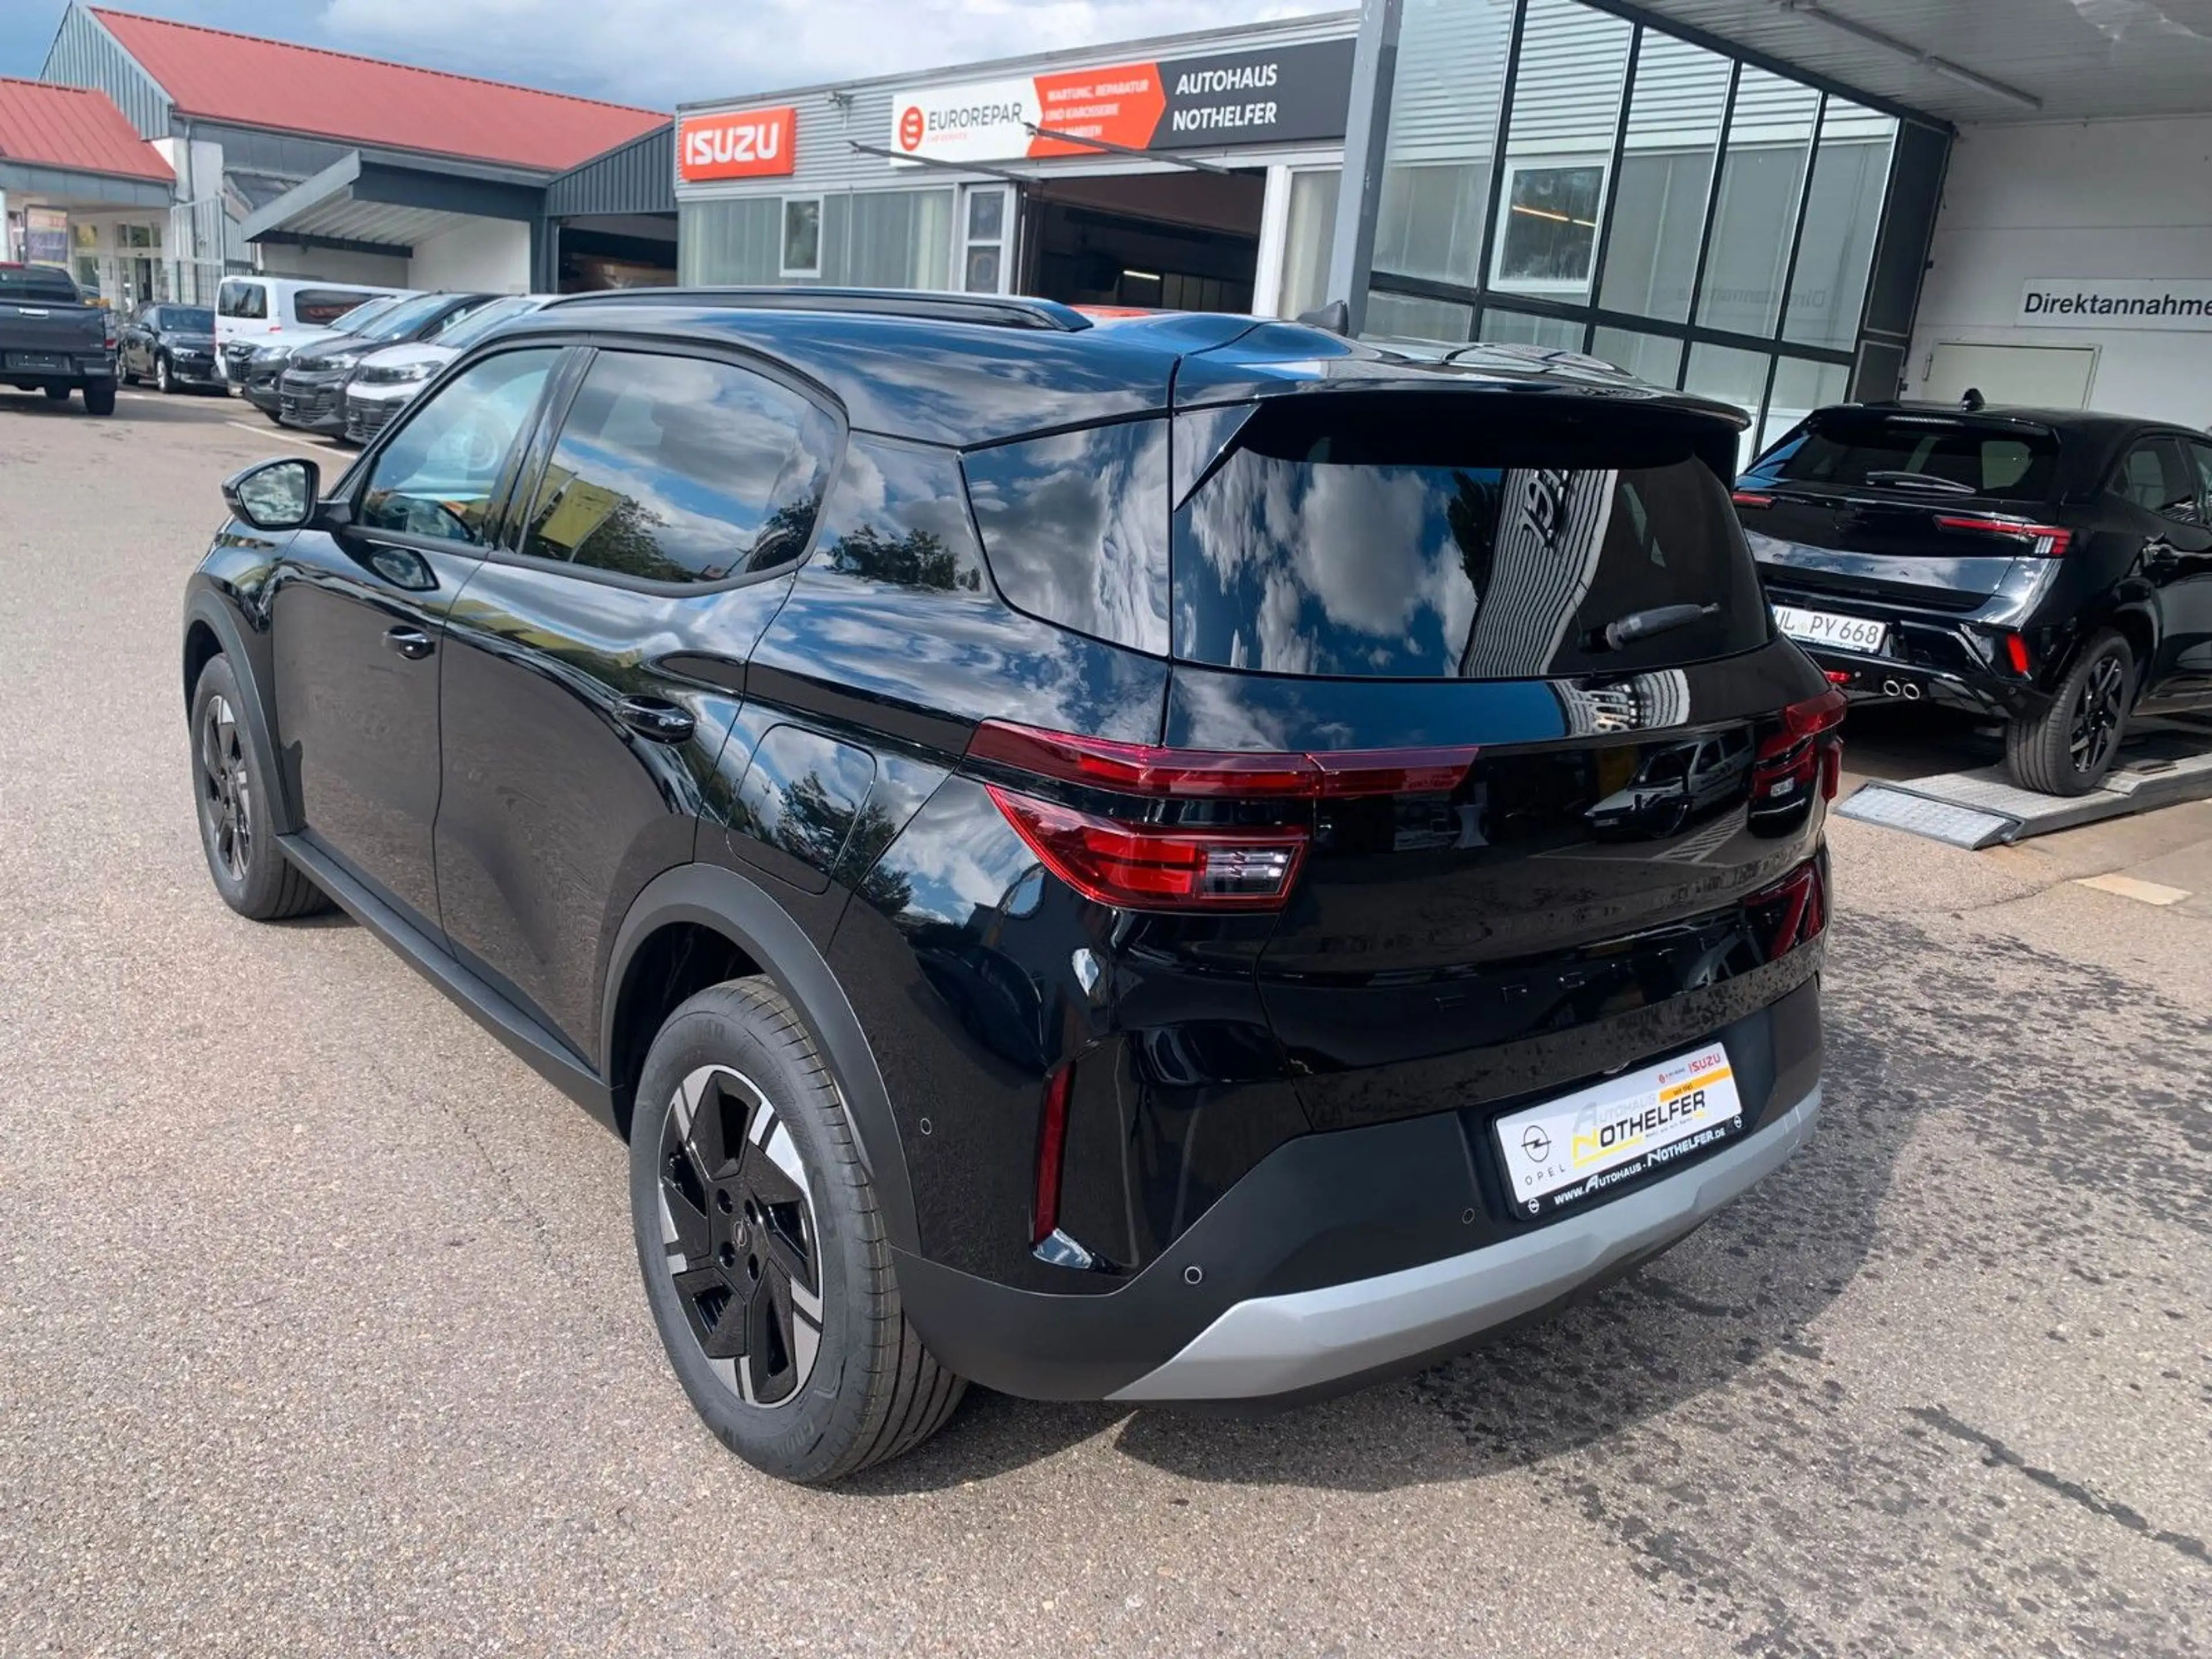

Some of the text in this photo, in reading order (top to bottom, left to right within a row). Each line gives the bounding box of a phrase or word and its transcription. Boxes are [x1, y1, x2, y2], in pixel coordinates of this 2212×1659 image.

[1175, 63, 1278, 95] AUTOHAUS
[928, 102, 1023, 131] EUROREPAR
[1173, 101, 1277, 131] NOTHELFER
[685, 122, 779, 166] ISUZU
[1809, 616, 1837, 637] PY
[1839, 622, 1878, 645] 668
[1688, 1053, 1721, 1073] ISUZU
[1573, 1090, 1706, 1161] NOTHELFER
[1524, 1163, 1566, 1185] OPEL
